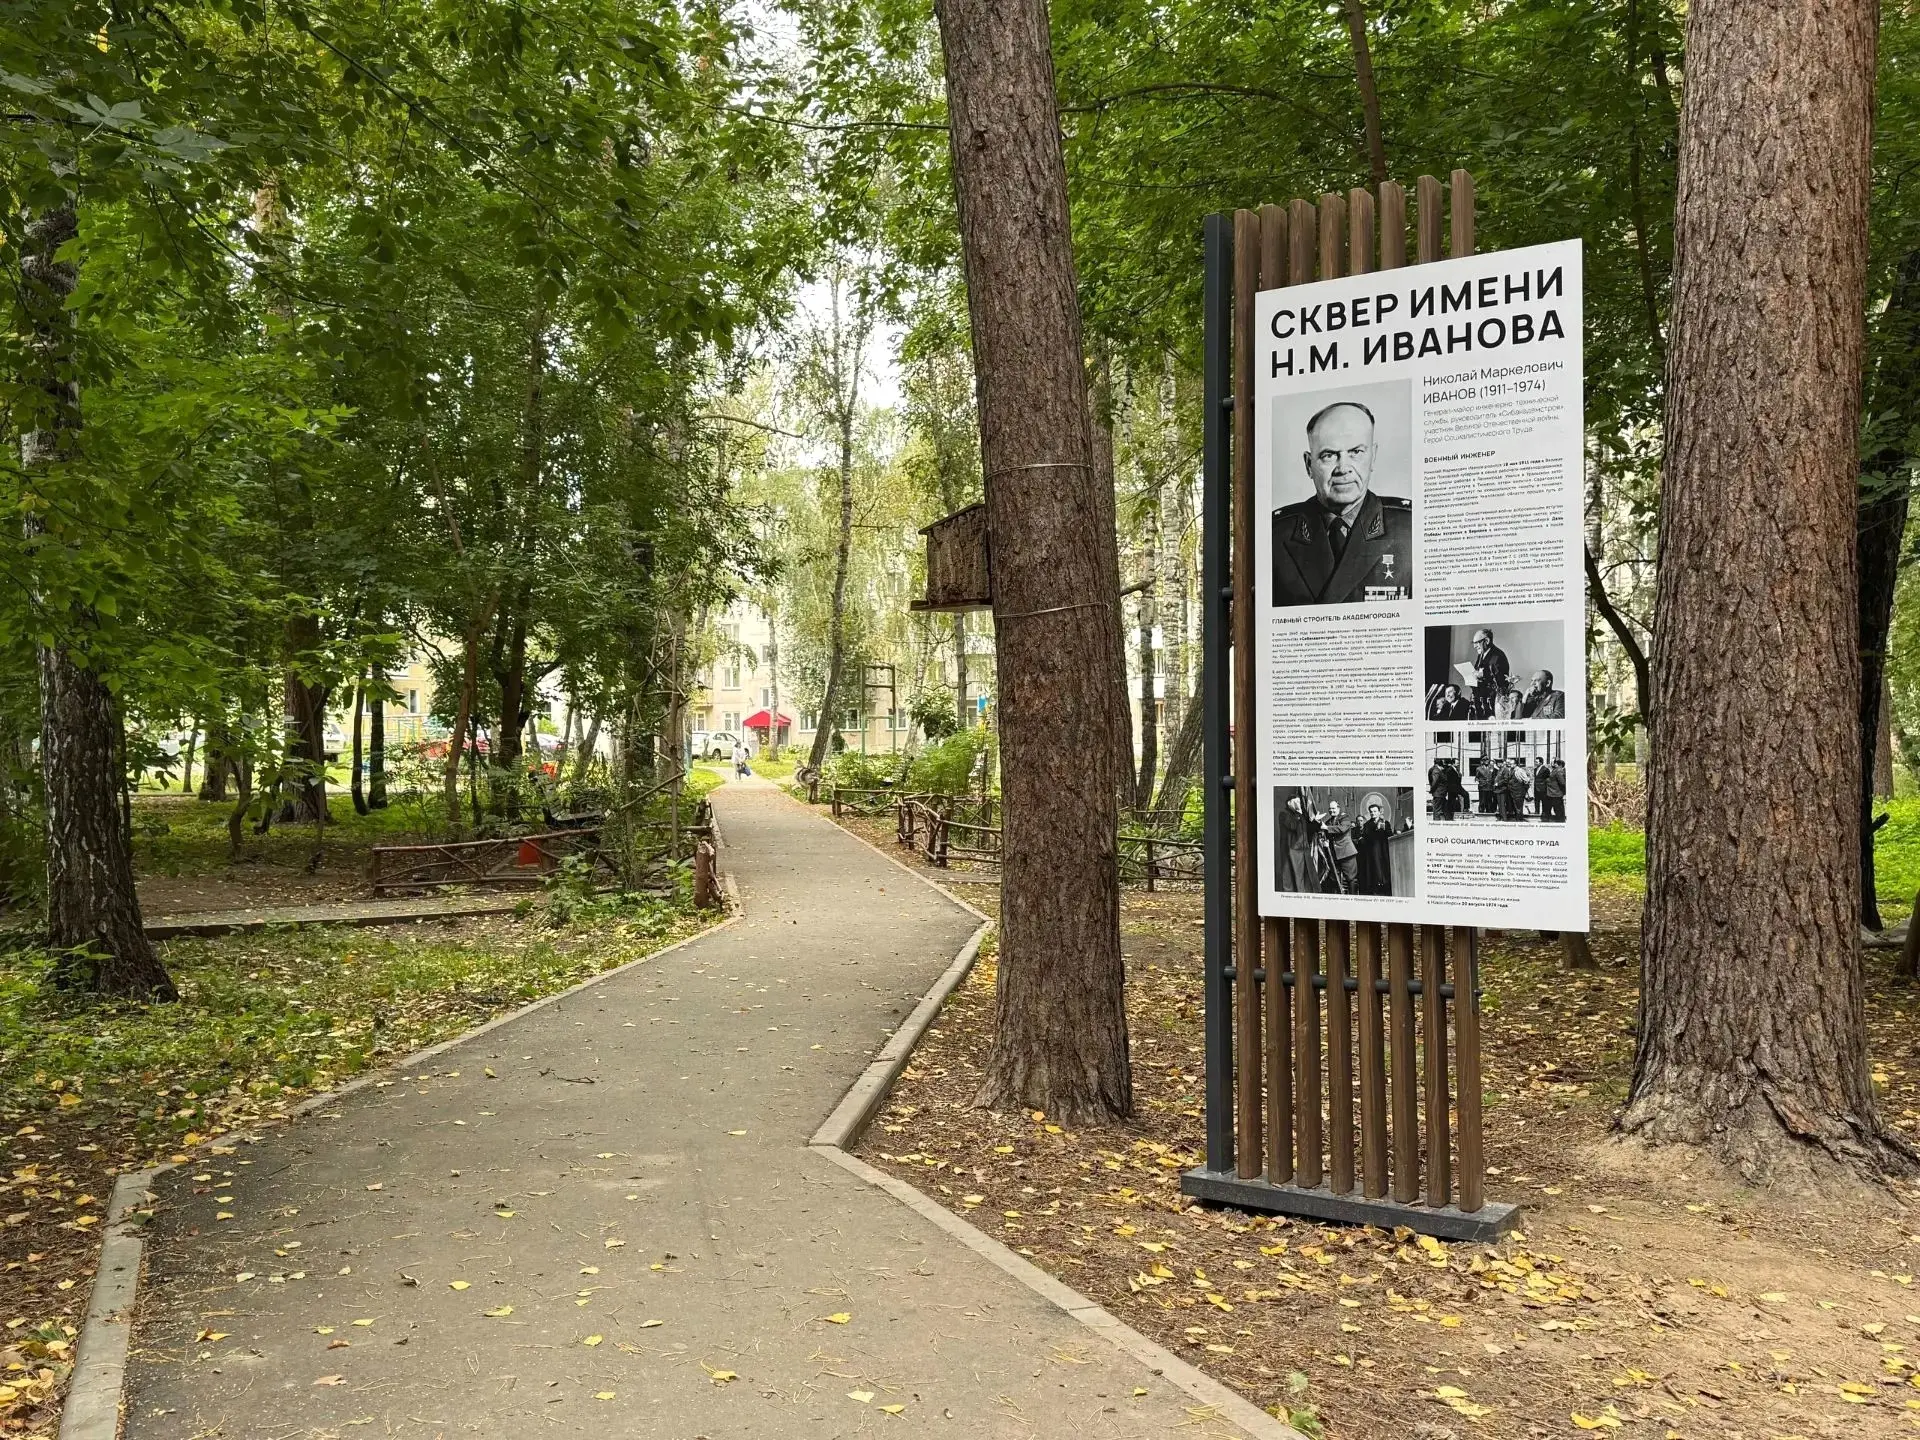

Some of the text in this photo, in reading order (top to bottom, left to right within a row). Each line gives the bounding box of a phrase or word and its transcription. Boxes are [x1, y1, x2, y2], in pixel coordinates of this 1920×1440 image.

[1271, 266, 1562, 339] СКВЕР ИМЕНИ
[1272, 310, 1565, 378] Н.М. ИВАНОВА
[1424, 361, 1563, 386] Николай Маркелович
[1424, 388, 1476, 404] ИВАНОВ
[1424, 451, 1495, 463] ВОЕННЫЙ ИНЖЕНЕР
[1272, 612, 1400, 624] ГЛАВНЫЙ СТРОИТЕЛЬ АКАДЕМГОРОДКА
[1451, 838, 1534, 846] СОЦИАЛИСТИЧЕСКОГО
